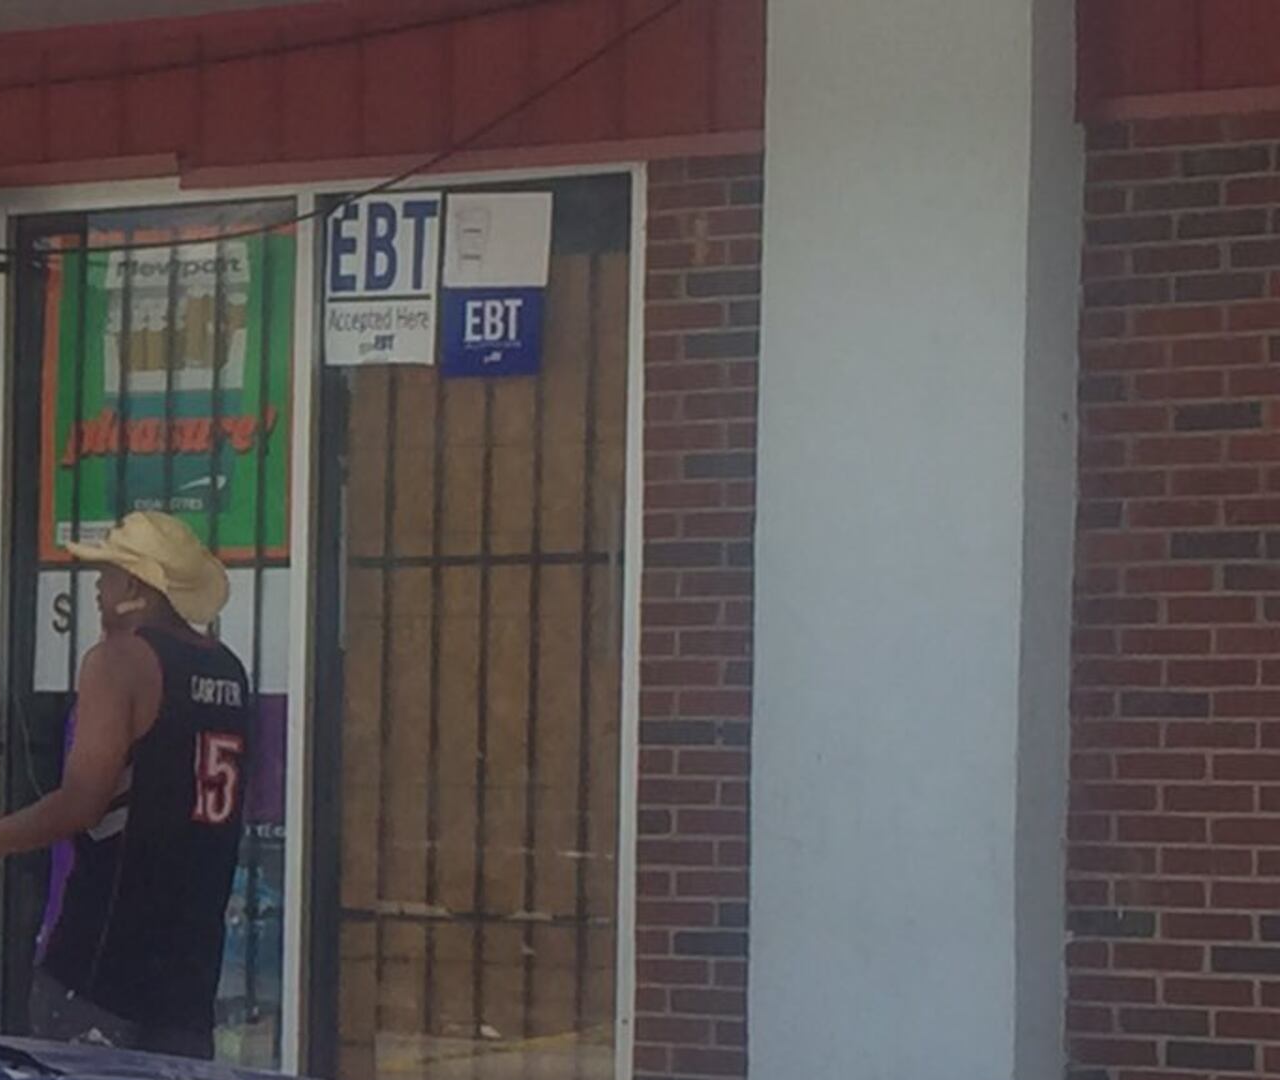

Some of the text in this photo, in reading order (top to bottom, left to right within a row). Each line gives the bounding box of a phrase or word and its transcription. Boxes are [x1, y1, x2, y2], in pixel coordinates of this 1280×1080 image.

[329, 200, 438, 292] EBT
[328, 306, 430, 332] Accepted Here
[464, 299, 523, 342] EBT
[192, 732, 244, 823] 15
